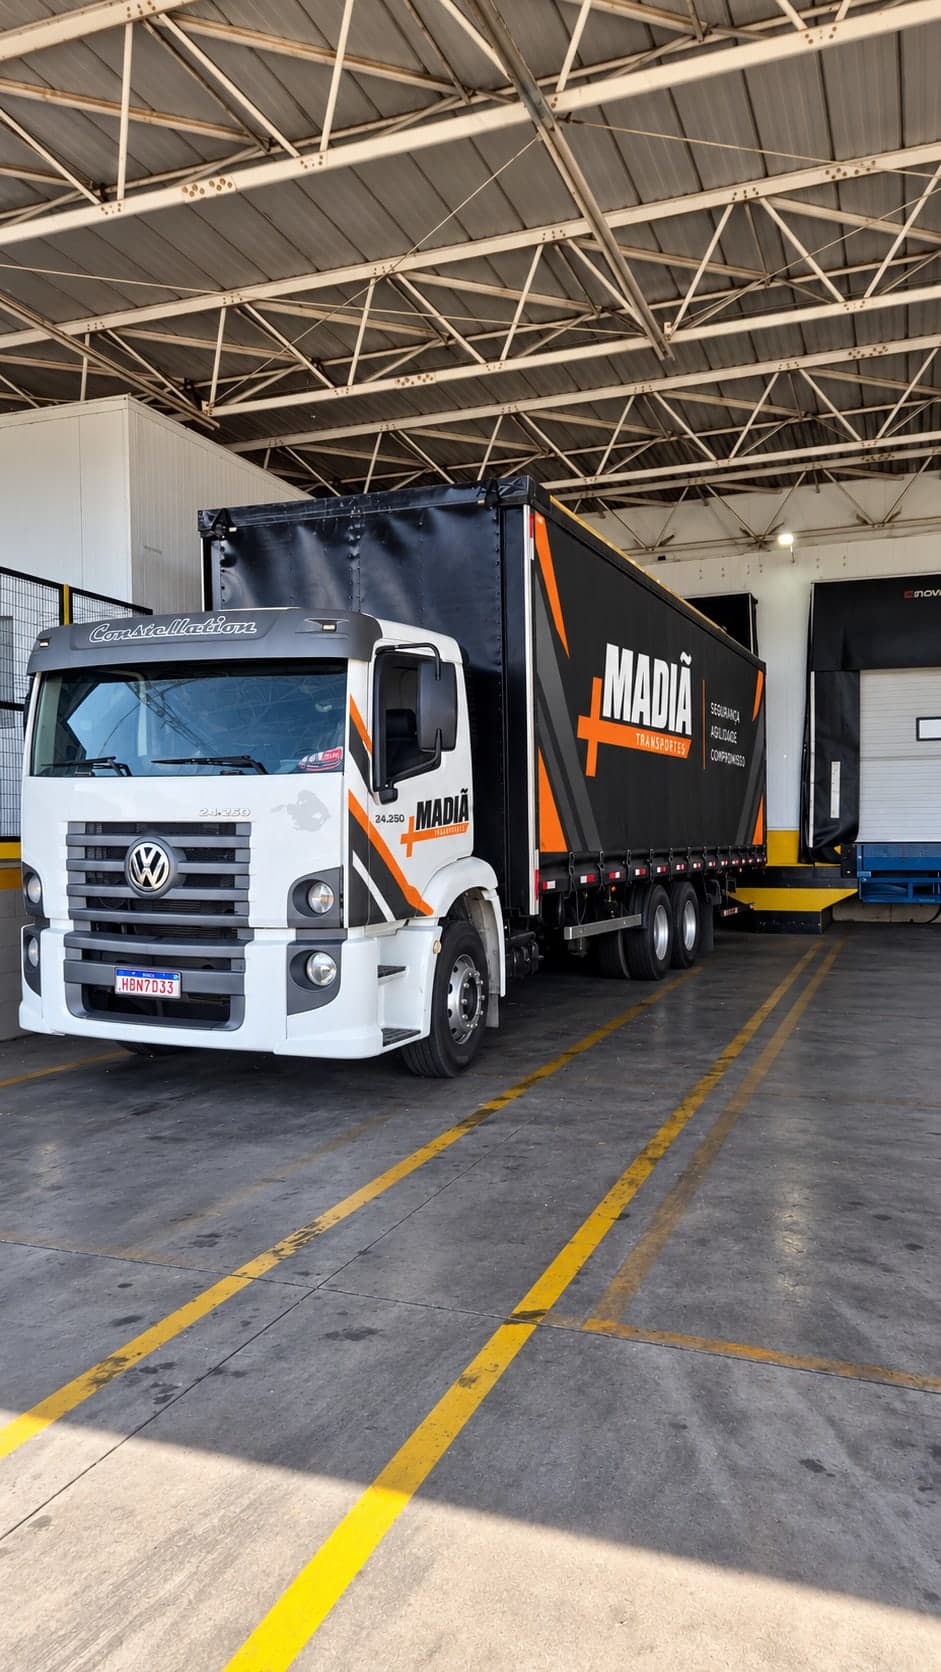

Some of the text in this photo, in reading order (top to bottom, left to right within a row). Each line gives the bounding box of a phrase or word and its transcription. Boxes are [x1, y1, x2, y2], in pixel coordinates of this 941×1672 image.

[89, 616, 257, 643] Constellation
[602, 642, 692, 736] MADIÃ
[711, 702, 740, 726] SEGURANÇA
[635, 733, 686, 756] TRANSPORTES
[711, 748, 746, 768] COMPROMISSO
[375, 814, 405, 824] 24.250
[415, 788, 469, 830] MADIÃ
[121, 977, 174, 995] HBN7D33
